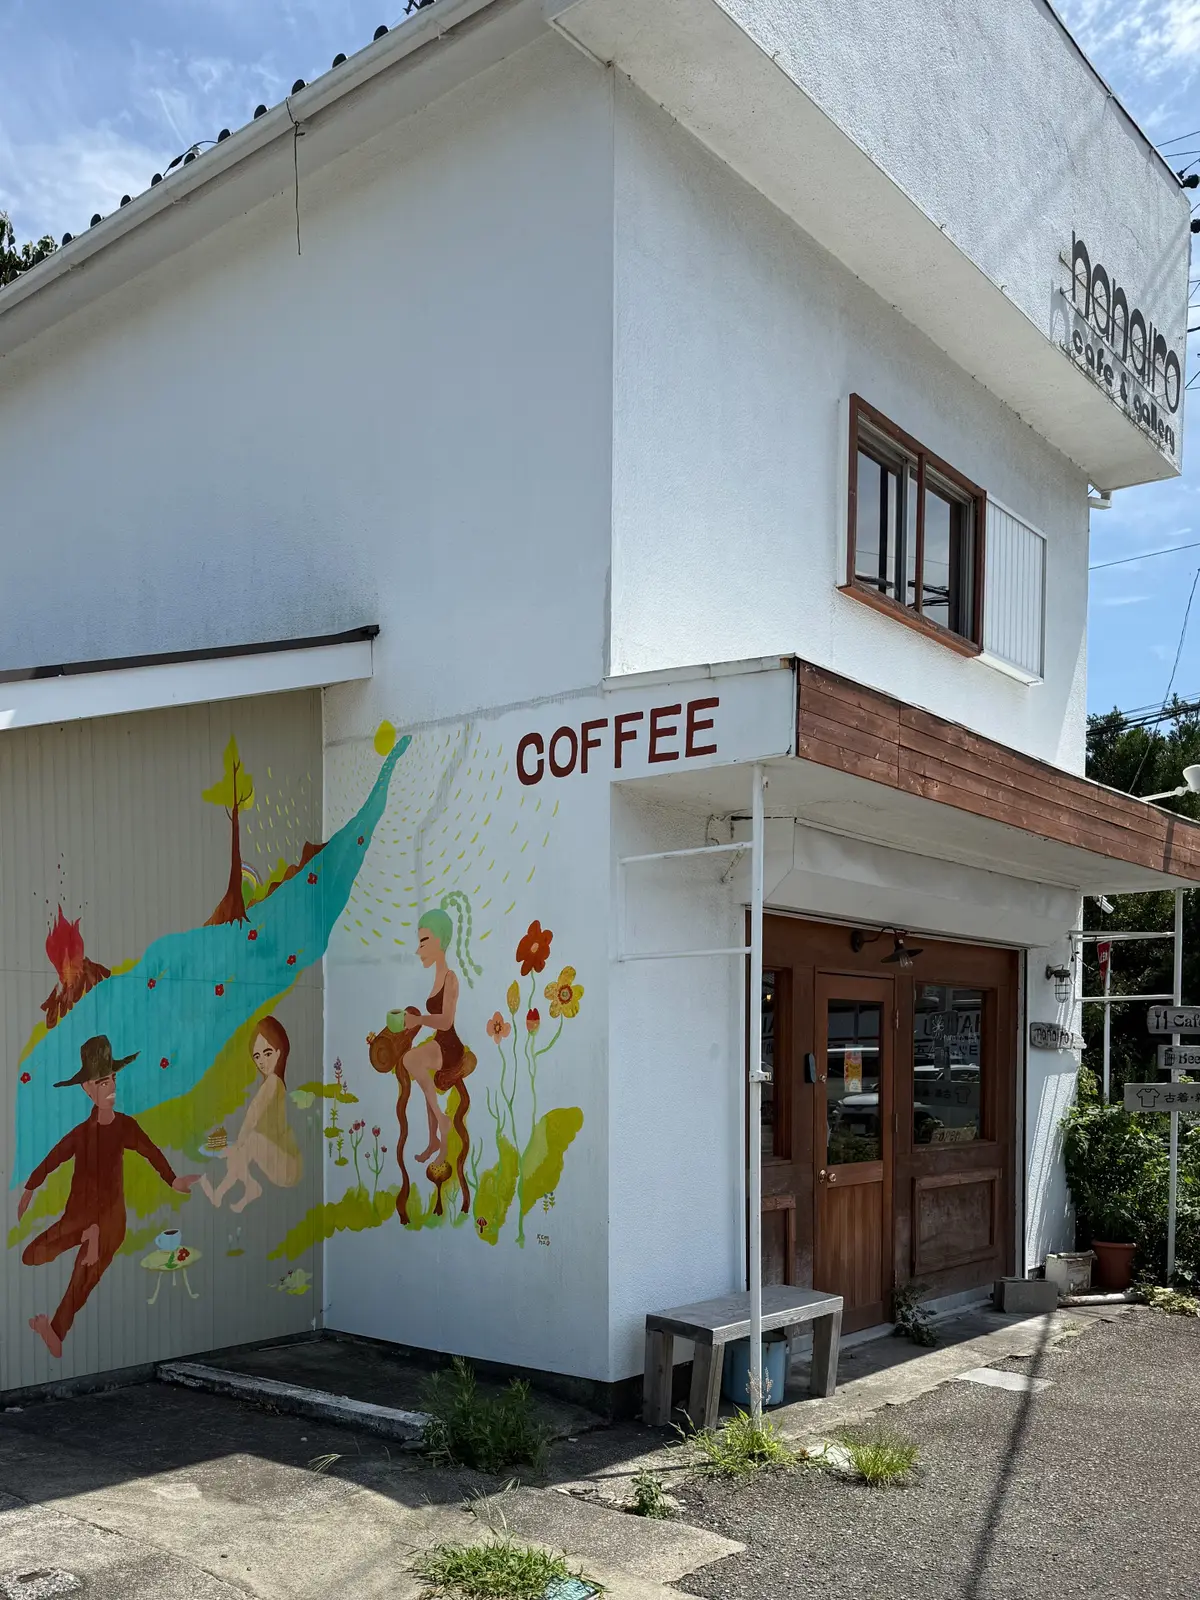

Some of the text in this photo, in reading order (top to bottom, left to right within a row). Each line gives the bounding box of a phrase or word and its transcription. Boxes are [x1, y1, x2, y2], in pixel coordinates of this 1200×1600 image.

[1071, 230, 1181, 413] nanairo
[1072, 329, 1114, 387] cafe
[1133, 393, 1175, 456] gallery
[516, 696, 720, 786] COFFEE
[1173, 1013, 1200, 1028] Caf
